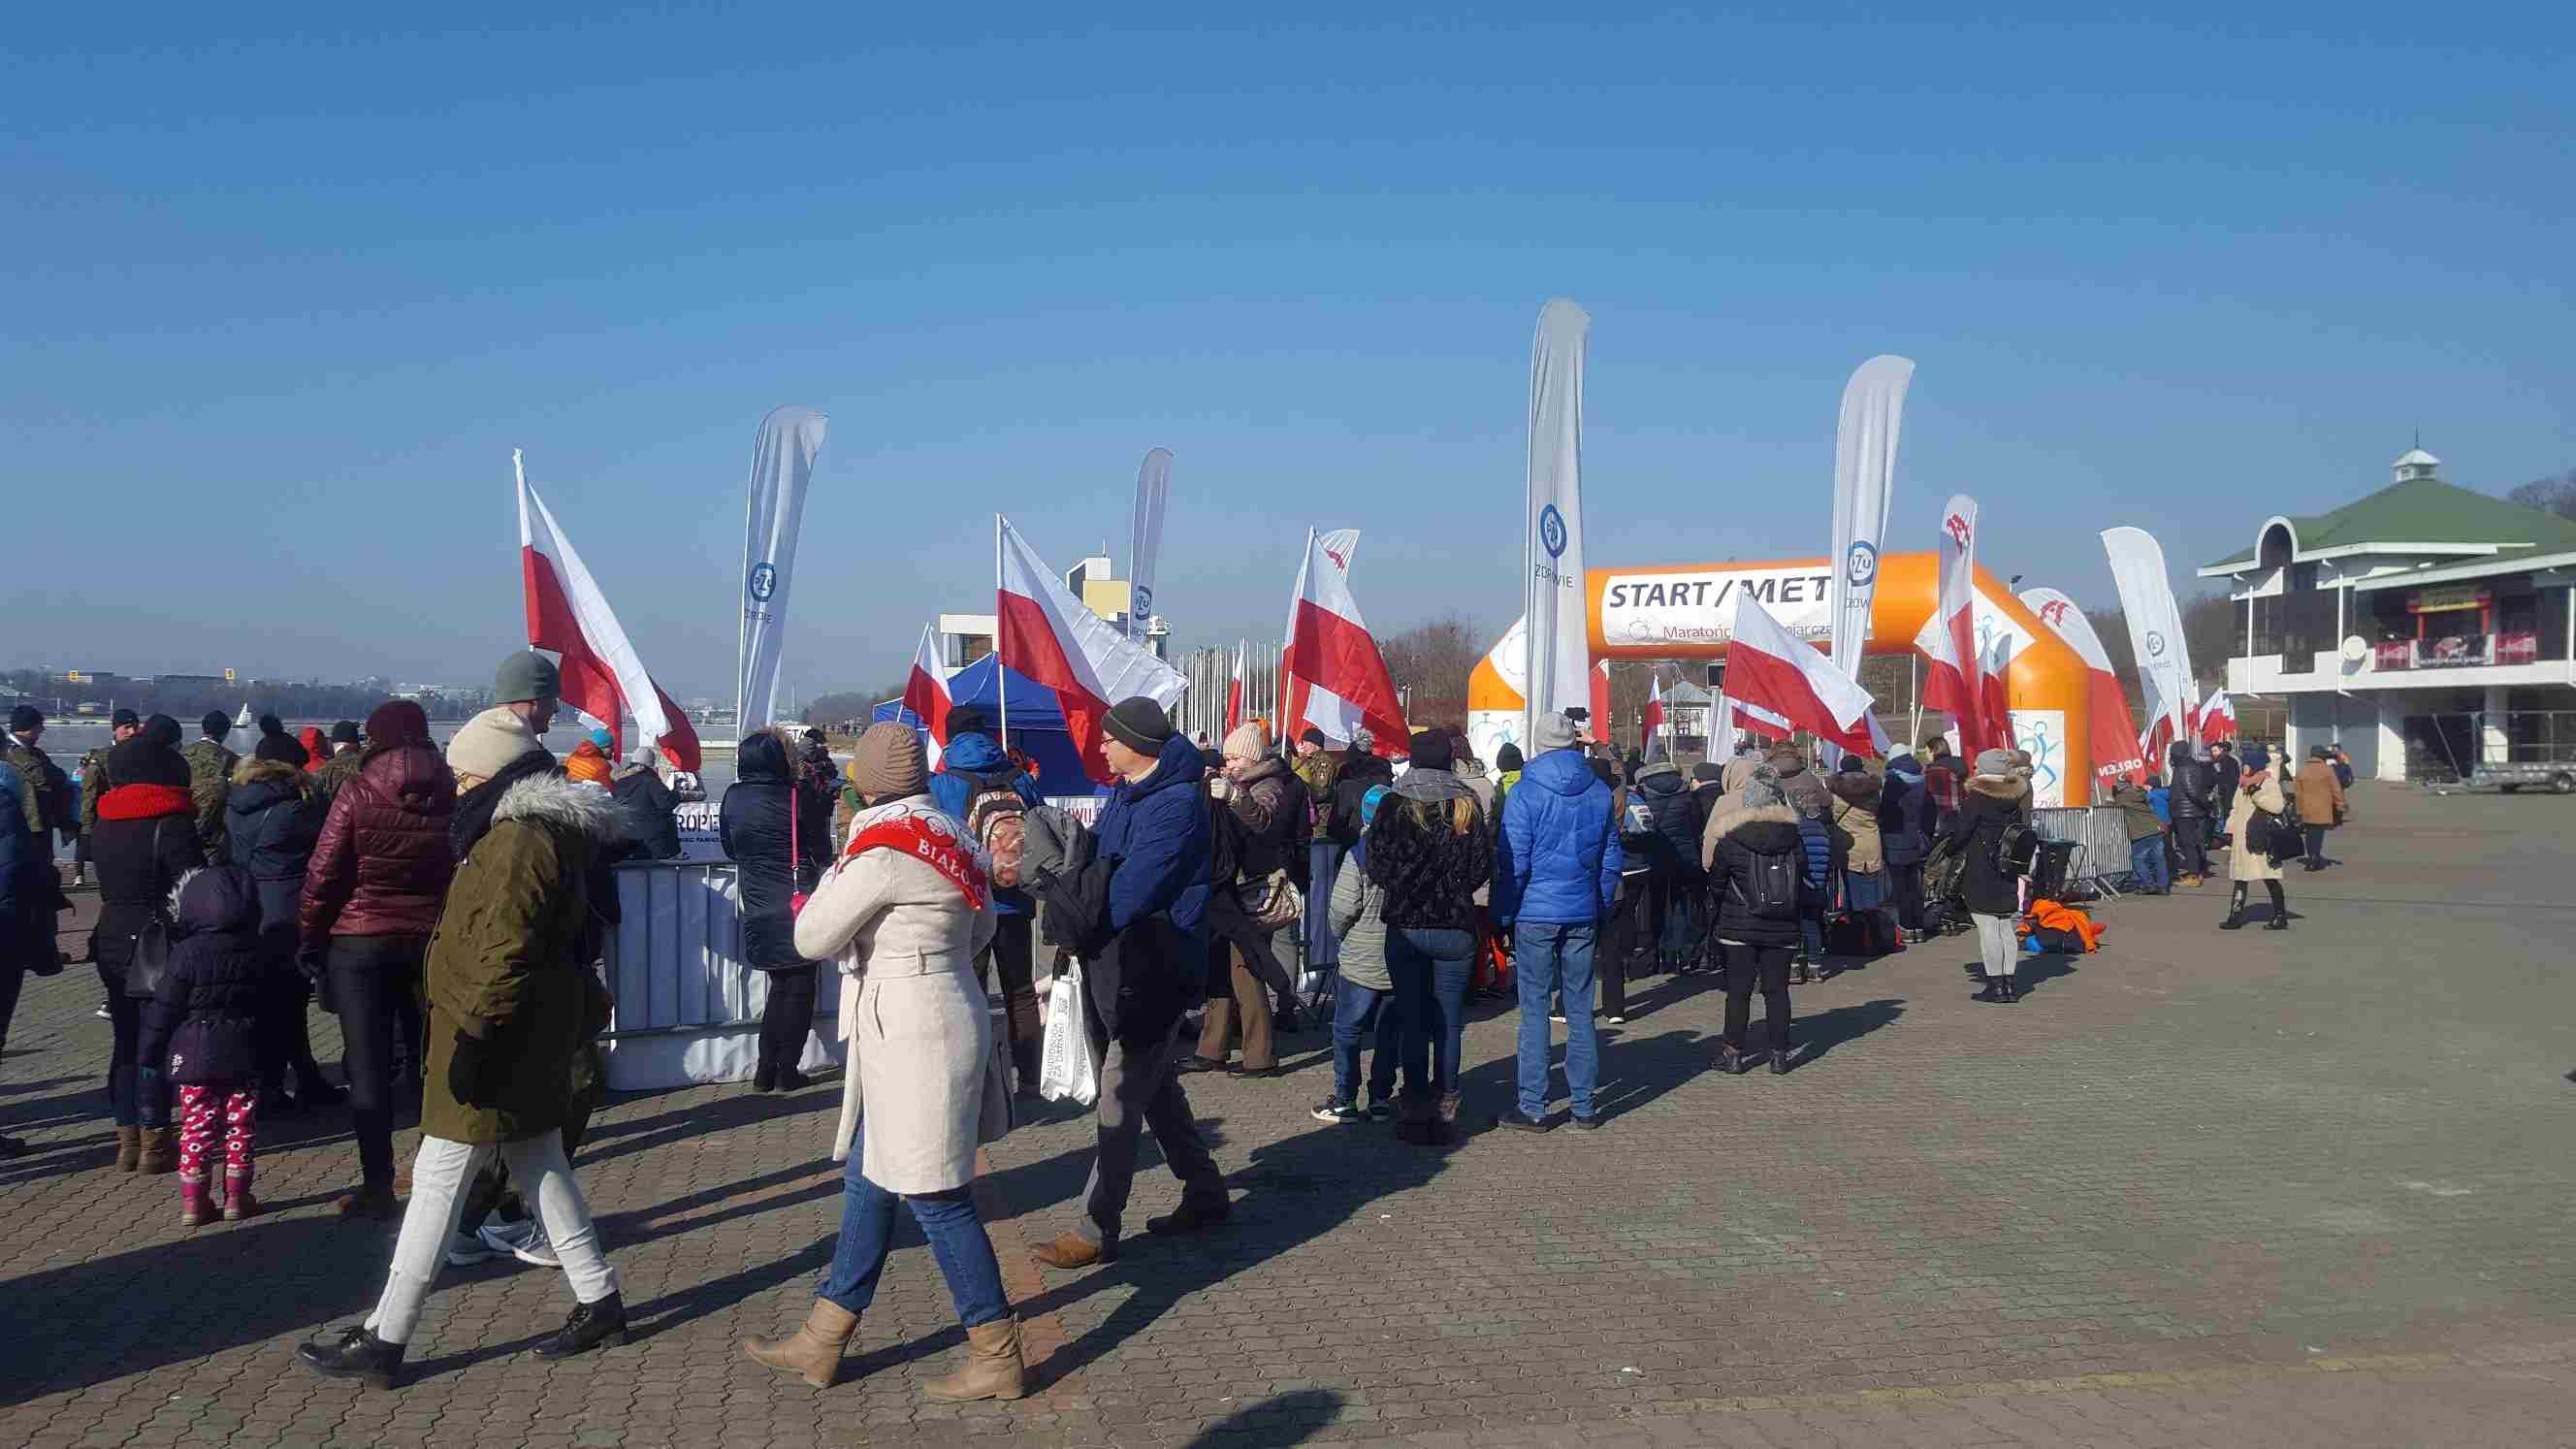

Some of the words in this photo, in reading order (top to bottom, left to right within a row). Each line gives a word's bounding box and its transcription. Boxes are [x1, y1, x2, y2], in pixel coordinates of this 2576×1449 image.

[1608, 574, 1832, 609] START/MET
[1662, 621, 1732, 638] Maratońc
[677, 814, 721, 832] ROPE
